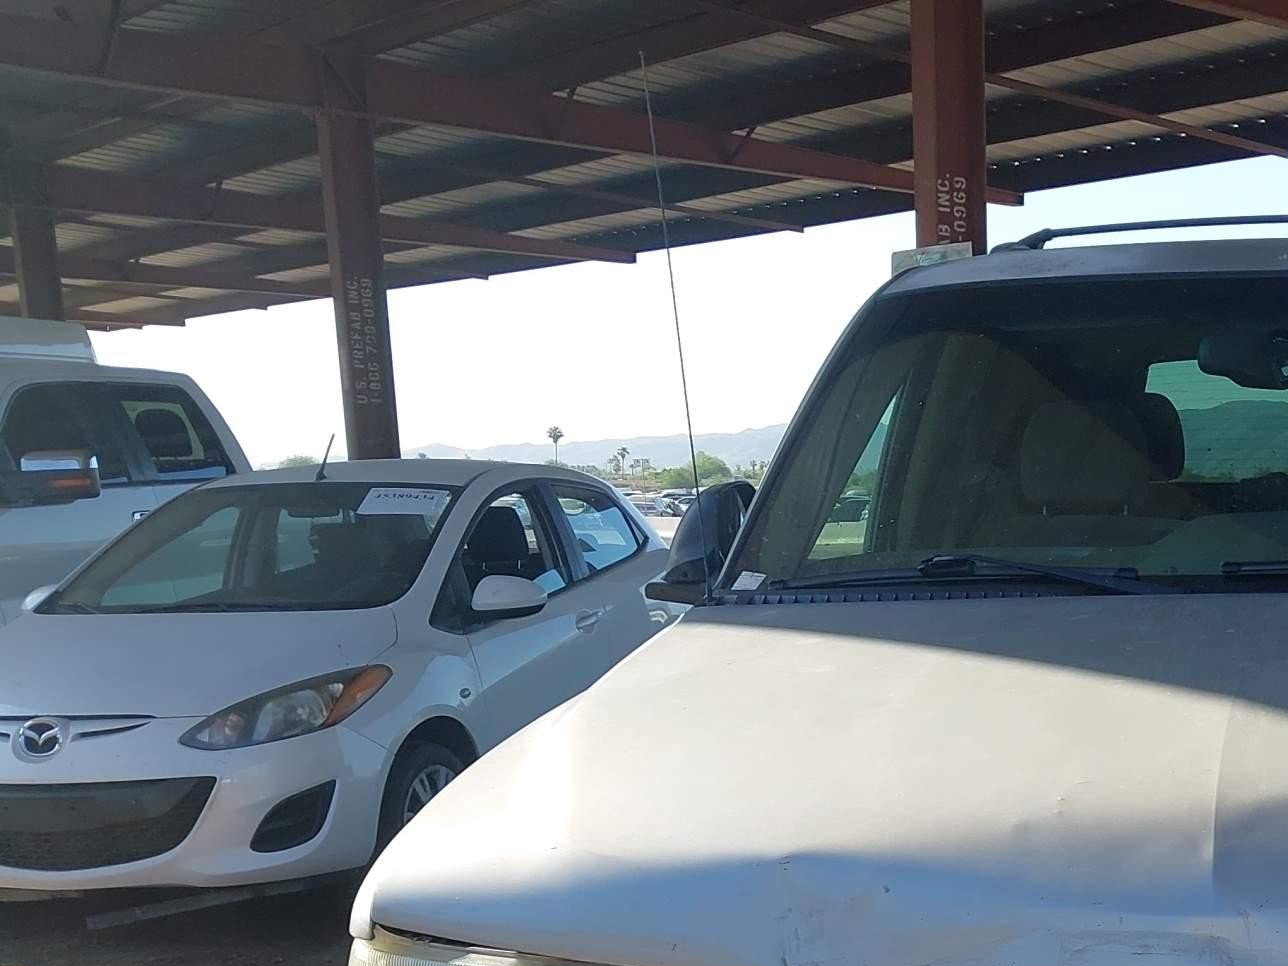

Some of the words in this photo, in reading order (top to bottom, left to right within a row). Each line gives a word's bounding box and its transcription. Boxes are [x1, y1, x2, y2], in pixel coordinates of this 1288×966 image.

[937, 173, 951, 213] INC.
[346, 276, 359, 304] INC.
[351, 311, 365, 369] PREFAB
